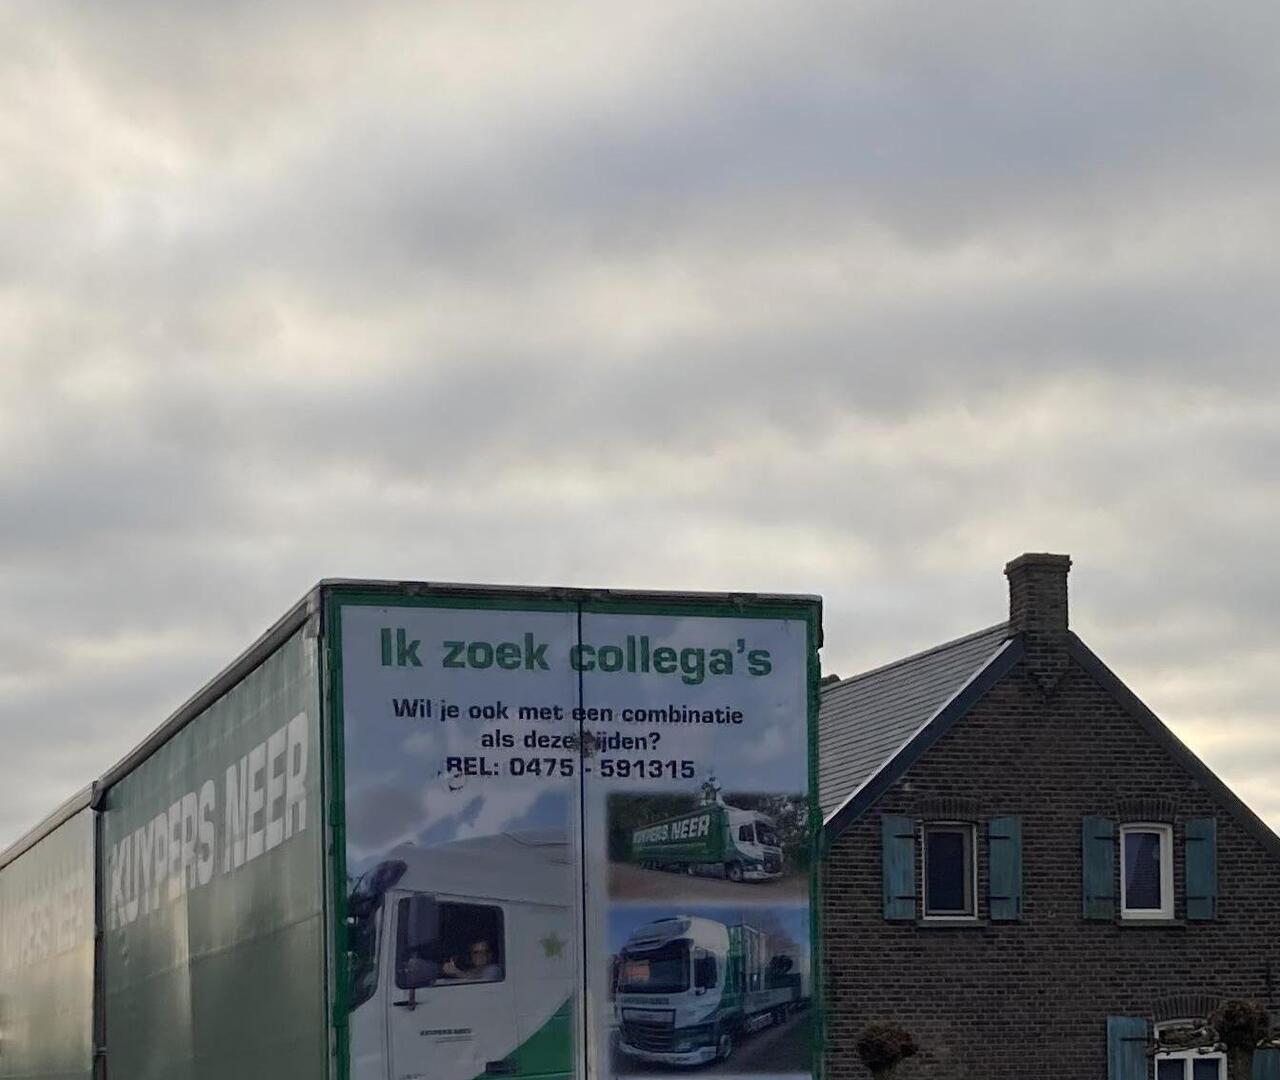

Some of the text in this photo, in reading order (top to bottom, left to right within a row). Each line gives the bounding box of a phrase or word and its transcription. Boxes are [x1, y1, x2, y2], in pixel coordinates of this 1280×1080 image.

[381, 627, 772, 685] Ik zoek collega's
[393, 699, 744, 725] Wil je ook met een combinatie
[481, 730, 661, 754] als deze ijden?
[510, 758, 574, 777] 0475
[600, 759, 695, 779] 591315
[223, 711, 309, 875] NEER
[671, 814, 710, 840] NEER
